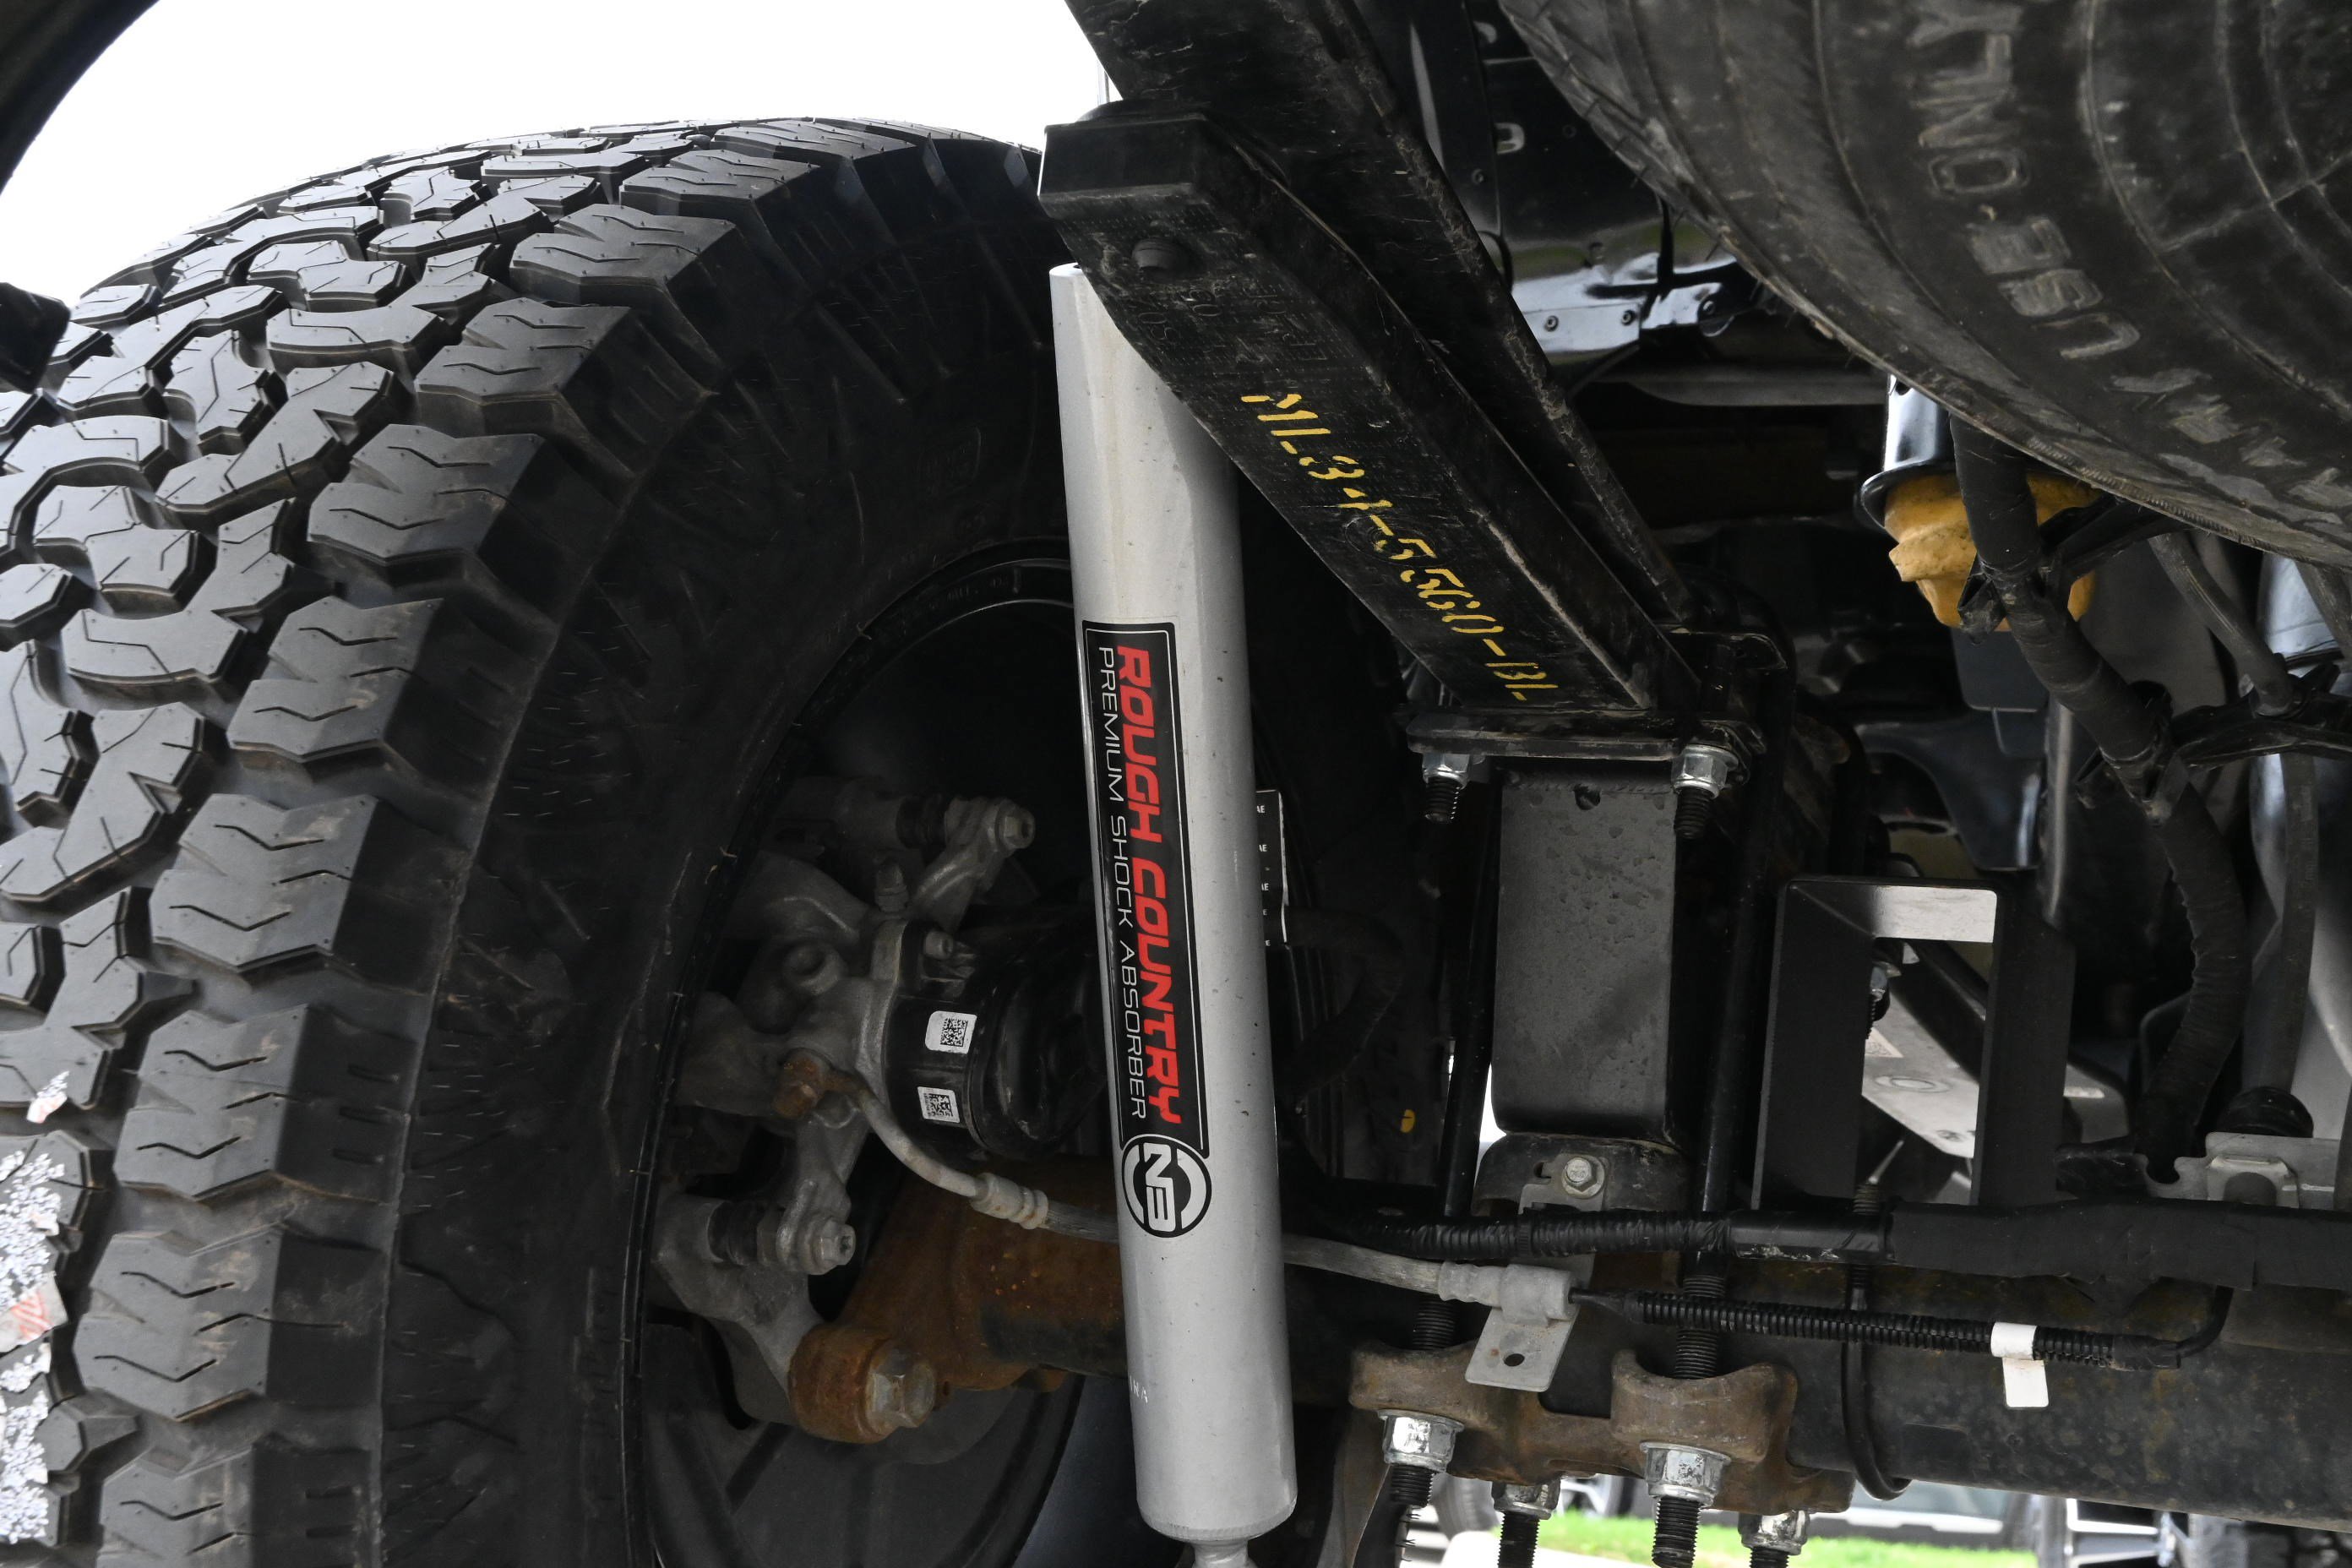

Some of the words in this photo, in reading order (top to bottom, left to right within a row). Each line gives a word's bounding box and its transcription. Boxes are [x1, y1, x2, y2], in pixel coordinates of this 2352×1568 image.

[1907, 0, 2028, 200] ONLY
[1965, 215, 2141, 360] USE
[1098, 646, 1124, 802] PREMIUM
[1117, 645, 1162, 843] ROUGH
[1110, 814, 1133, 928] SHOCK
[1120, 939, 1146, 1119] ABSORBER
[1132, 857, 1182, 1124] COUNTRY
